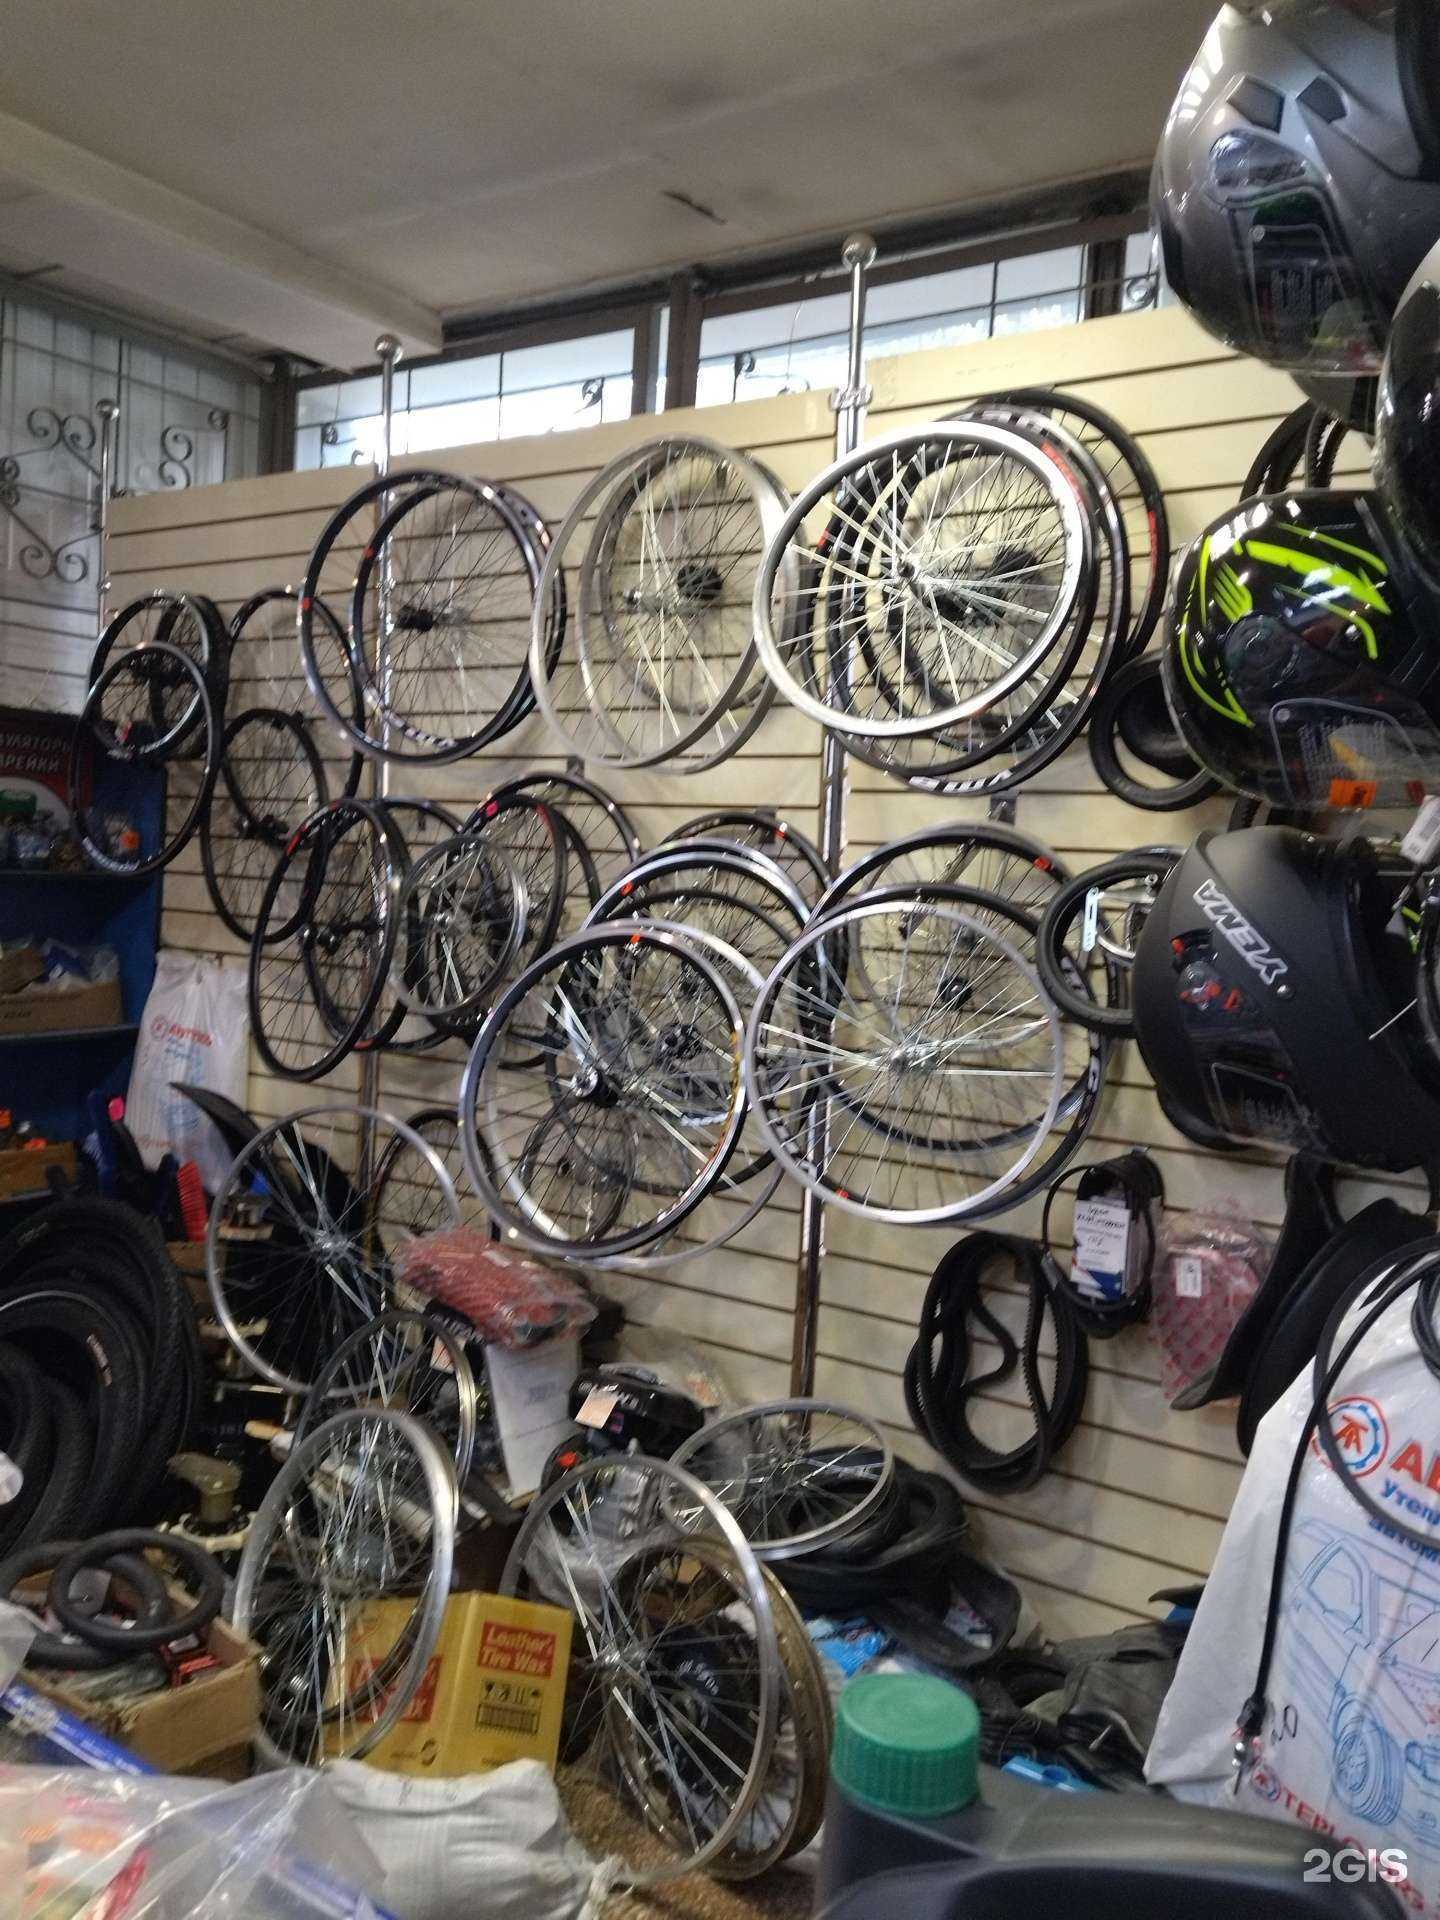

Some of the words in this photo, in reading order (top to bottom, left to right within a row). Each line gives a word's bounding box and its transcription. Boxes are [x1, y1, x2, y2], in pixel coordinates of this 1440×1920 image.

[1193, 879, 1288, 985] YEMA
[482, 1646, 512, 1670] Tire
[513, 1651, 547, 1674] Wax
